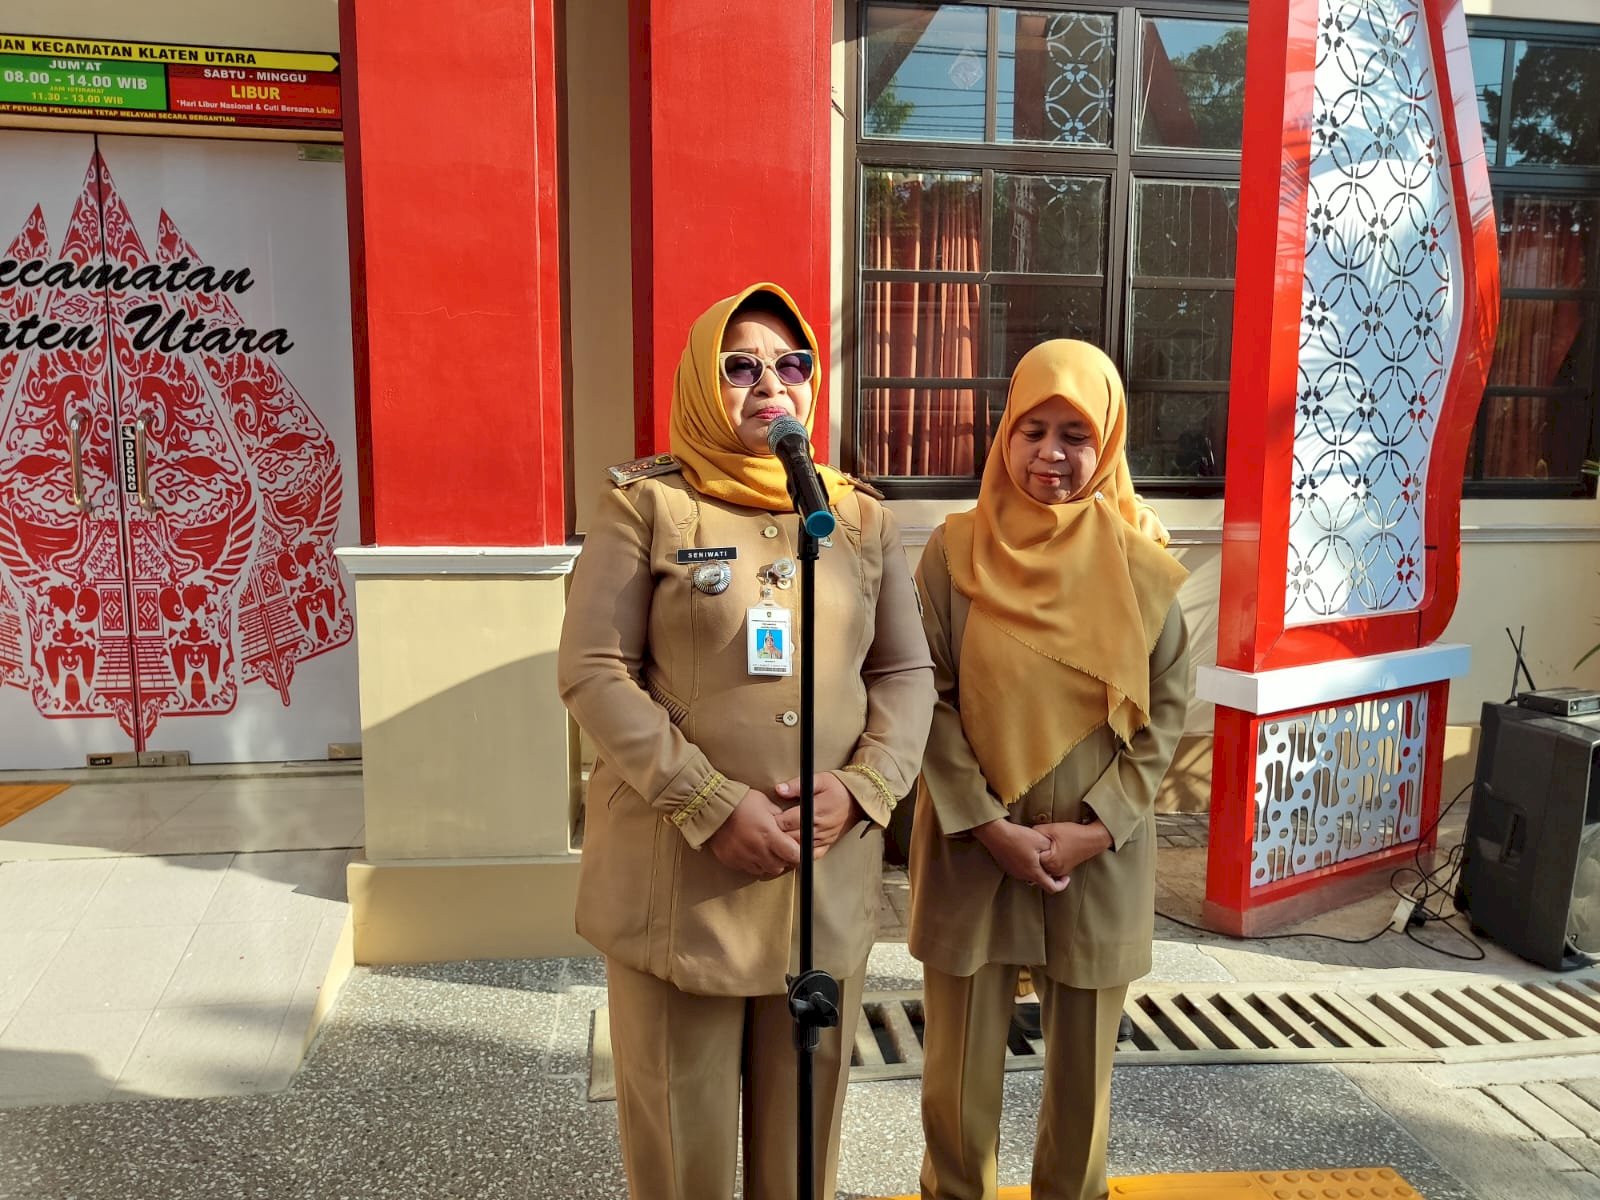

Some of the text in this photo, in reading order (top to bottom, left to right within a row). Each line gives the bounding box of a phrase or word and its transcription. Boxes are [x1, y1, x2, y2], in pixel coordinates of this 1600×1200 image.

[32, 41, 132, 56] KECAMATAN
[138, 47, 198, 61] KLATEN
[205, 51, 256, 64] UTARA
[49, 60, 102, 71] JUM'AT
[4, 70, 50, 84] 08.00
[67, 73, 112, 88] 14.00
[117, 76, 148, 90] WIB
[204, 69, 246, 79] SABTU
[256, 71, 307, 83] MINGGU
[231, 85, 280, 100] LIBUR
[103, 96, 124, 105] WIB
[198, 101, 218, 109] Libur
[220, 101, 254, 111] Nasional
[263, 104, 279, 112] Cuti
[281, 105, 315, 114] Bersama
[316, 106, 336, 115] Libur
[12, 105, 48, 113] PETUGAS
[158, 112, 188, 120] SECARA
[123, 303, 294, 355] Utara
[125, 441, 137, 491] DORONG
